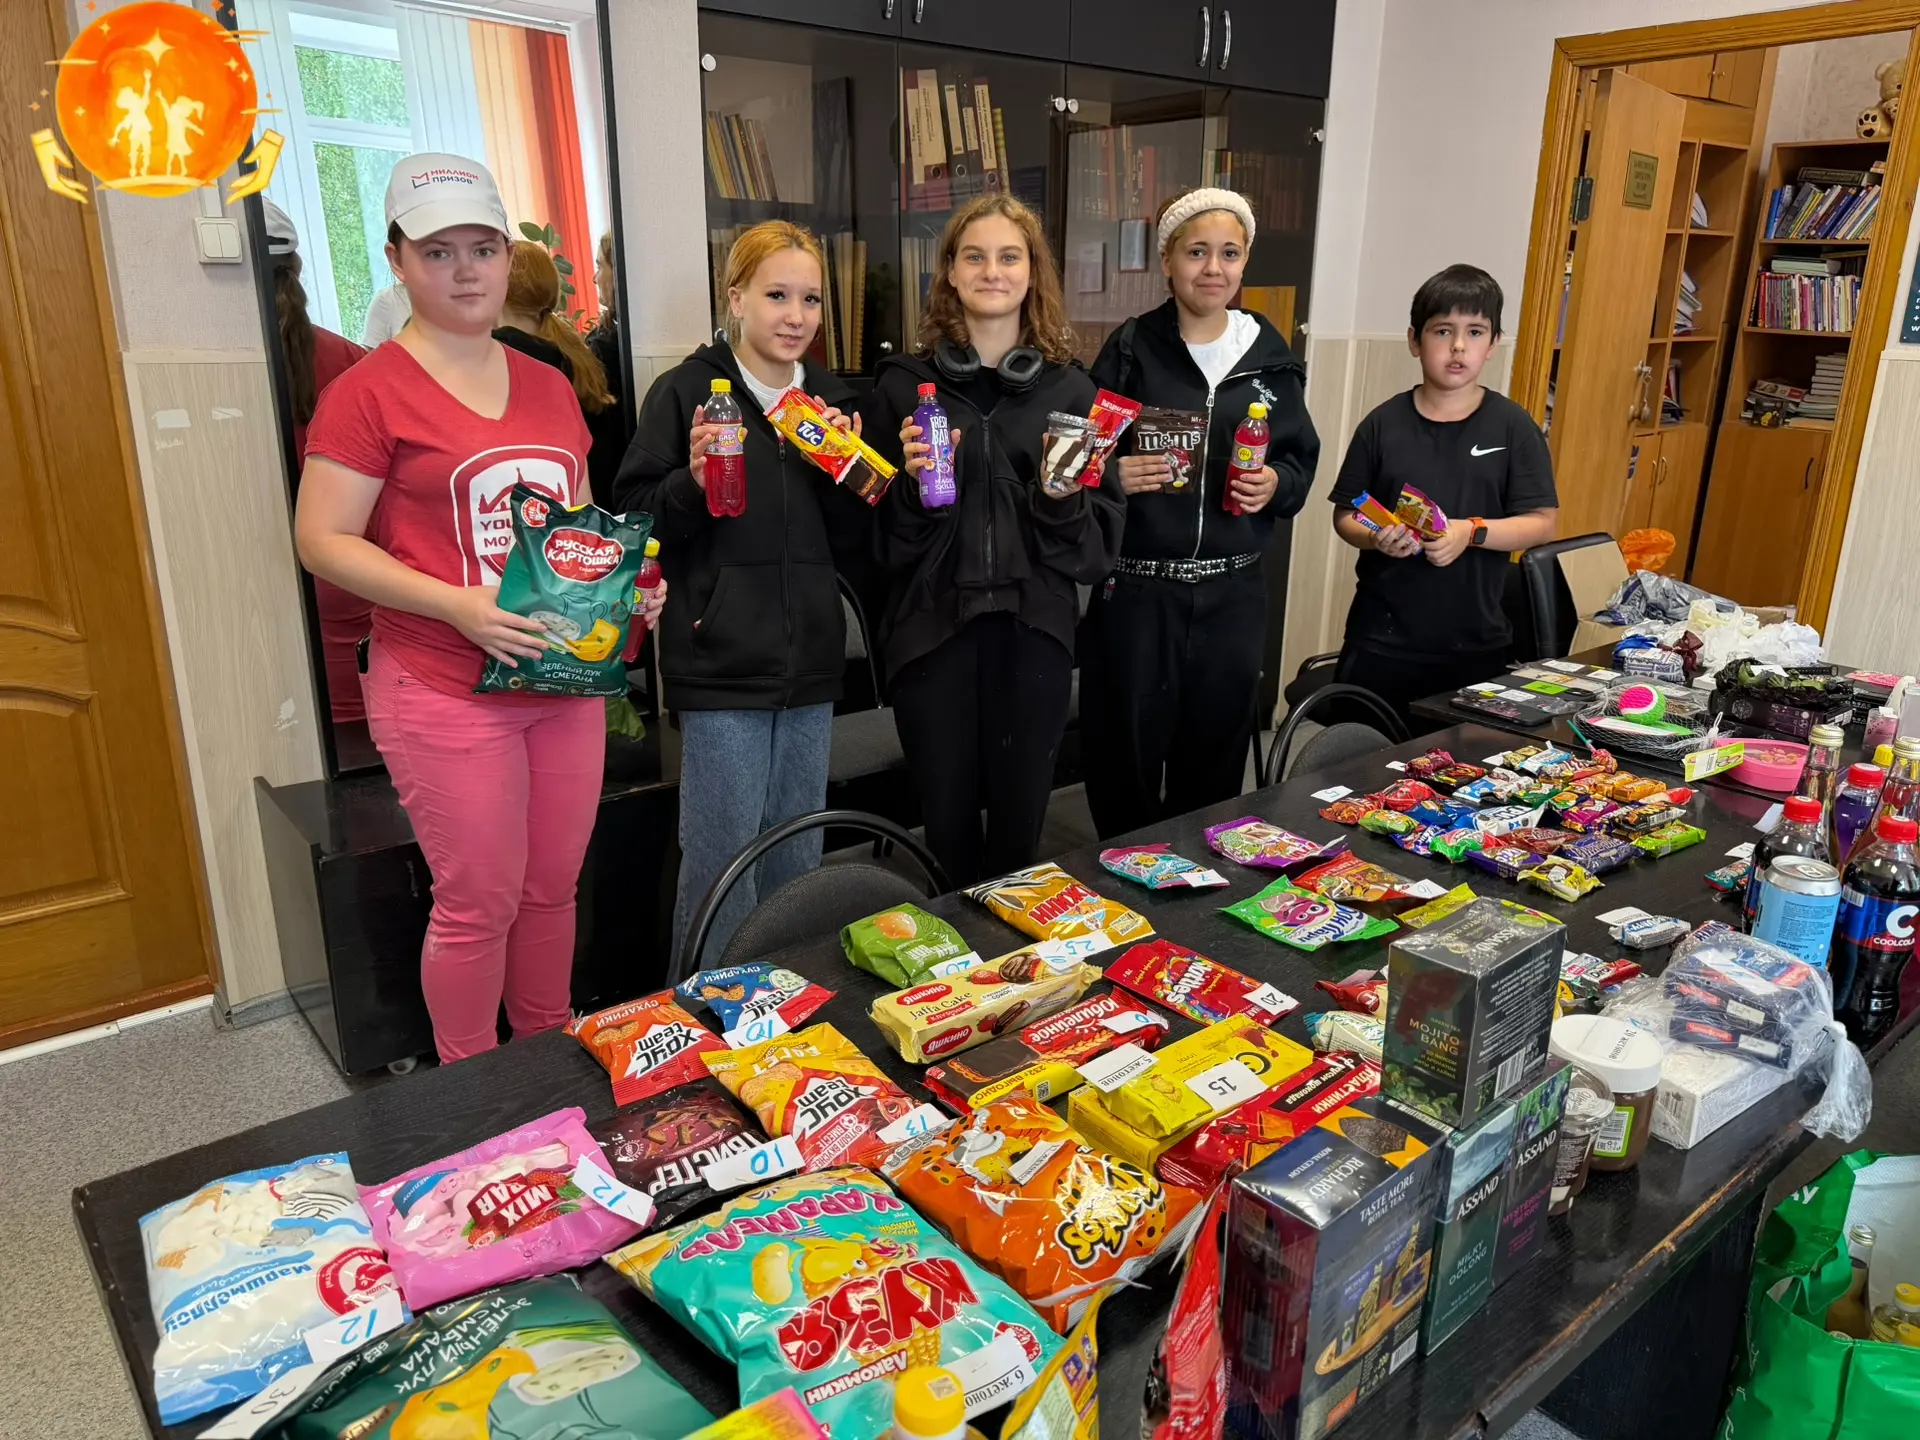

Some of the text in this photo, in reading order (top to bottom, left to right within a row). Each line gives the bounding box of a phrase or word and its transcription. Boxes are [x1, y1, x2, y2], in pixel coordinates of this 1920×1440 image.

[931, 428, 950, 446] BAR
[484, 537, 511, 548] MO
[547, 549, 621, 566] КАРТОШКА
[554, 538, 615, 555] РУССКАЯ
[552, 671, 593, 683] СМЕТАНА
[584, 668, 602, 677] ЛУК
[1885, 904, 1919, 938] C
[703, 965, 761, 984] СУХАРИКИ
[740, 989, 786, 1009] team
[903, 984, 948, 1005] Яшкино
[909, 991, 973, 1021] Jaffa Cake
[1260, 990, 1285, 1006] 20
[596, 999, 660, 1028] СУХАРИКИ
[1031, 997, 1120, 1041] Юбилейное
[636, 1021, 685, 1052] team
[926, 1027, 969, 1054] Яшкино
[1409, 1018, 1460, 1046] MOJITO
[1420, 1033, 1459, 1056] BANG
[1101, 1056, 1145, 1087] жетонов
[1208, 1075, 1238, 1098] 15
[800, 1078, 847, 1108] team
[819, 1124, 843, 1149] ВМЕСТЕ
[835, 1122, 863, 1150] ФУТБОЛ
[904, 1113, 928, 1136] 13
[750, 1142, 784, 1176] 10
[1514, 1129, 1557, 1171] ASSAND
[1309, 1156, 1365, 1198] RICHARD
[477, 1181, 531, 1216] BAR
[498, 1183, 555, 1228] MIX
[1360, 1171, 1415, 1223] TASTE MORE
[1456, 1175, 1500, 1222] ASSAND
[677, 1188, 906, 1263] КАРАМЕЛЬ
[1448, 1246, 1487, 1286] OOLONG
[1456, 1239, 1484, 1269] MILKY
[338, 1307, 379, 1346] 12
[438, 1296, 532, 1363] ЗЕЛЁНЫЙ
[775, 1256, 981, 1374] КУЗЯ
[394, 1361, 436, 1395] ЛУК
[805, 1348, 909, 1406] Лакомкин
[964, 1363, 1026, 1409] 6 жетоно
